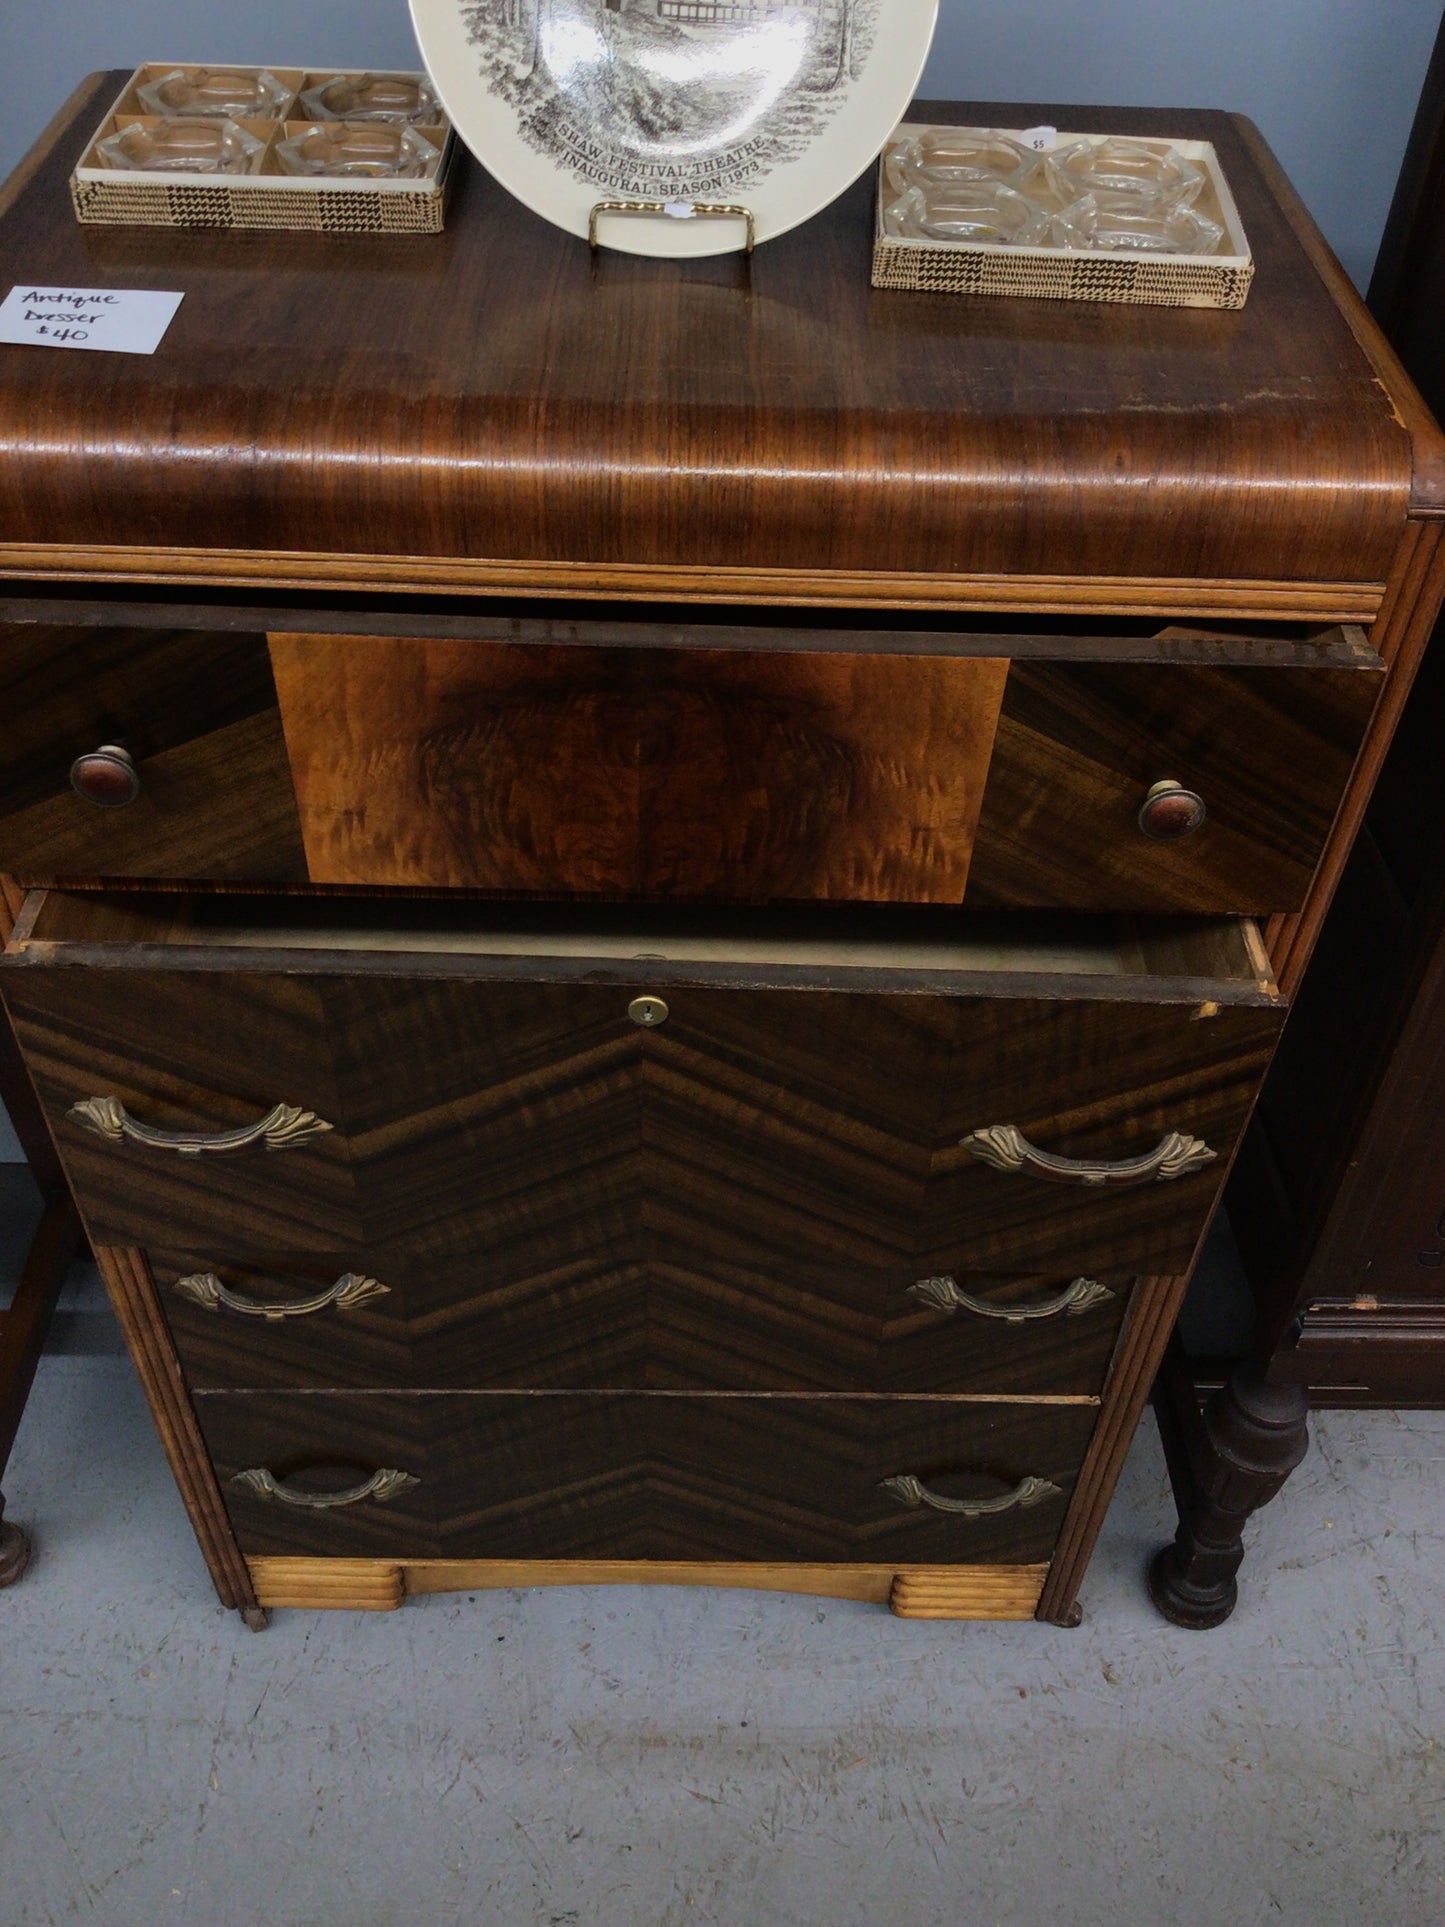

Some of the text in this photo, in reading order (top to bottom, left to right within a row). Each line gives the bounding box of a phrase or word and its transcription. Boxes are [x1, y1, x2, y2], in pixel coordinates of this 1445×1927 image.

[559, 124, 765, 177] SHAW FESTIVAL THEATRE
[563, 151, 761, 196] INAUGURAL SEASON 1973
[21, 291, 120, 308] Antique
[24, 309, 104, 324] Dresser
[36, 325, 88, 341] $40
